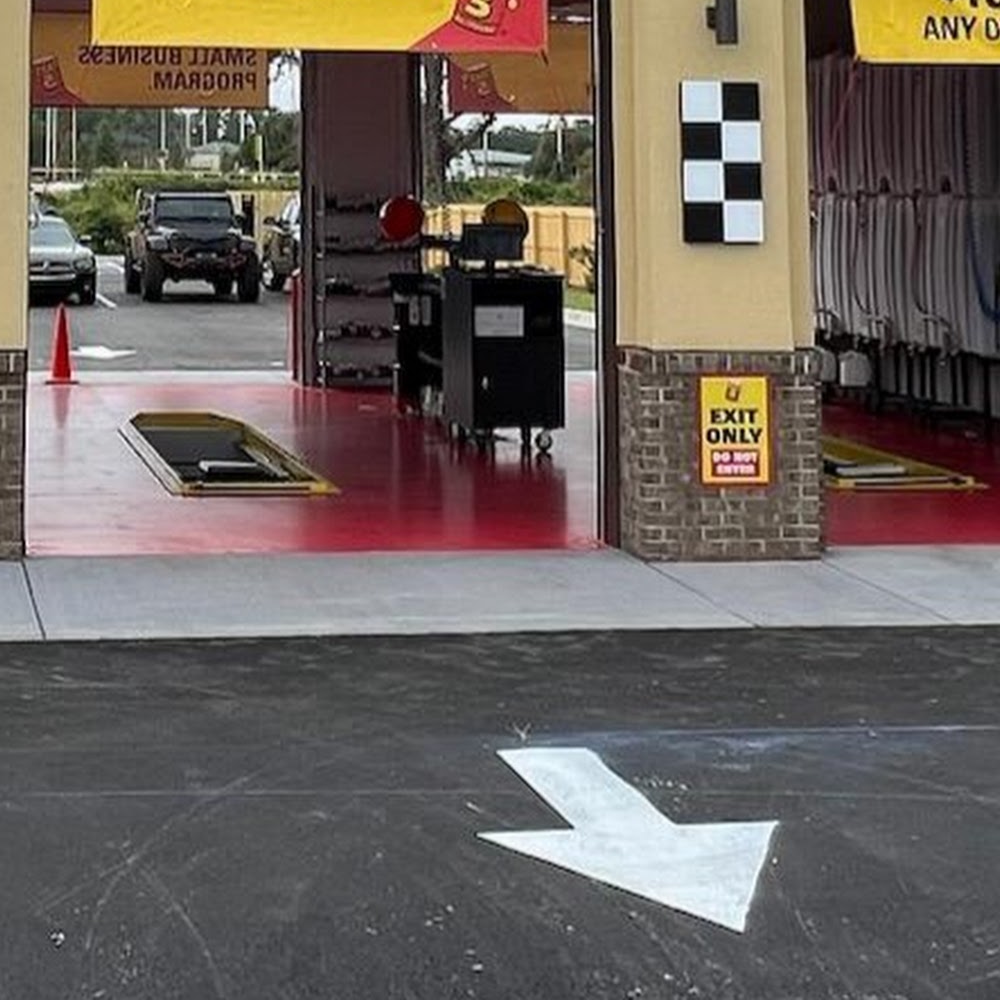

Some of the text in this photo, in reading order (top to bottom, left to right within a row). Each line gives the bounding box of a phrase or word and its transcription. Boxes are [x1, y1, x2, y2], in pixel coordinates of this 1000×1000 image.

[923, 15, 977, 41] ANY
[710, 408, 758, 424] EXIT
[706, 428, 763, 444] ONLY
